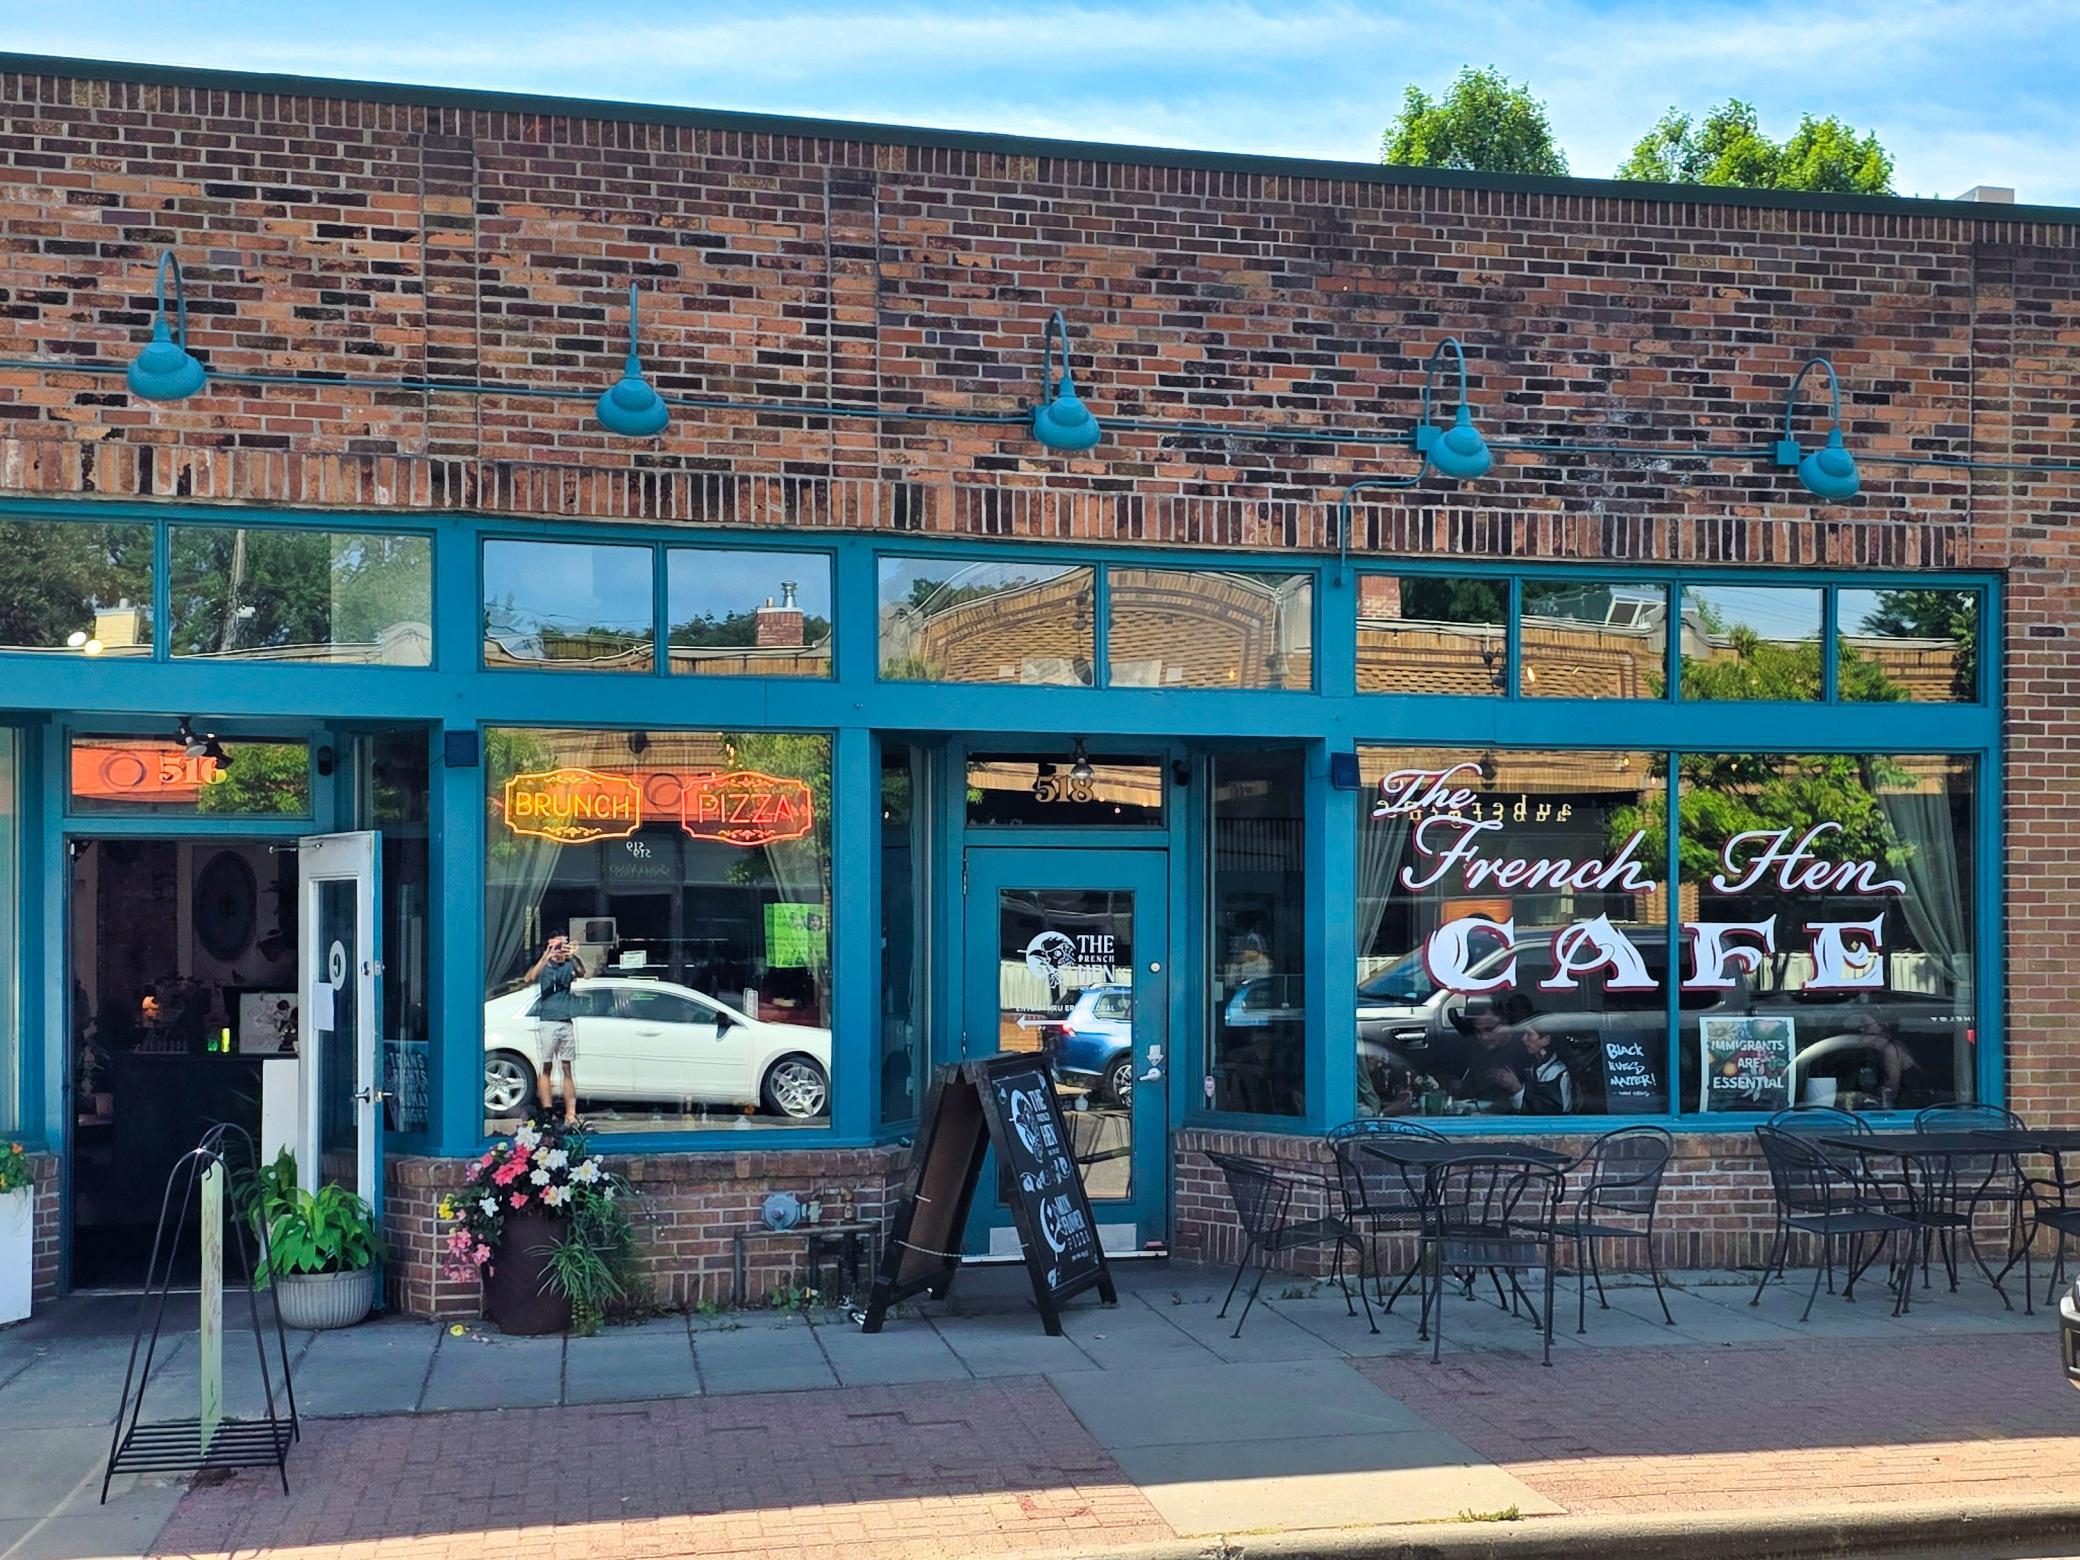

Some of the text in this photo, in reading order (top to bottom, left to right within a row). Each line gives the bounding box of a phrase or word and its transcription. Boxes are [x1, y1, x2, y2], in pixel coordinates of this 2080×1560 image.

[159, 755, 227, 785] 516
[1035, 775, 1094, 803] 518
[1371, 762, 1483, 820] The
[515, 791, 630, 819] BRUNCH
[698, 793, 795, 823] PIZZA
[1400, 815, 1906, 894] French Hen
[1077, 935, 1115, 953] THE
[1423, 911, 1885, 995] CAFE
[1711, 1040, 1785, 1051] IMMIGRANTS
[1737, 1058, 1761, 1069] ARE
[1713, 1076, 1785, 1089] ESSENTIAL
